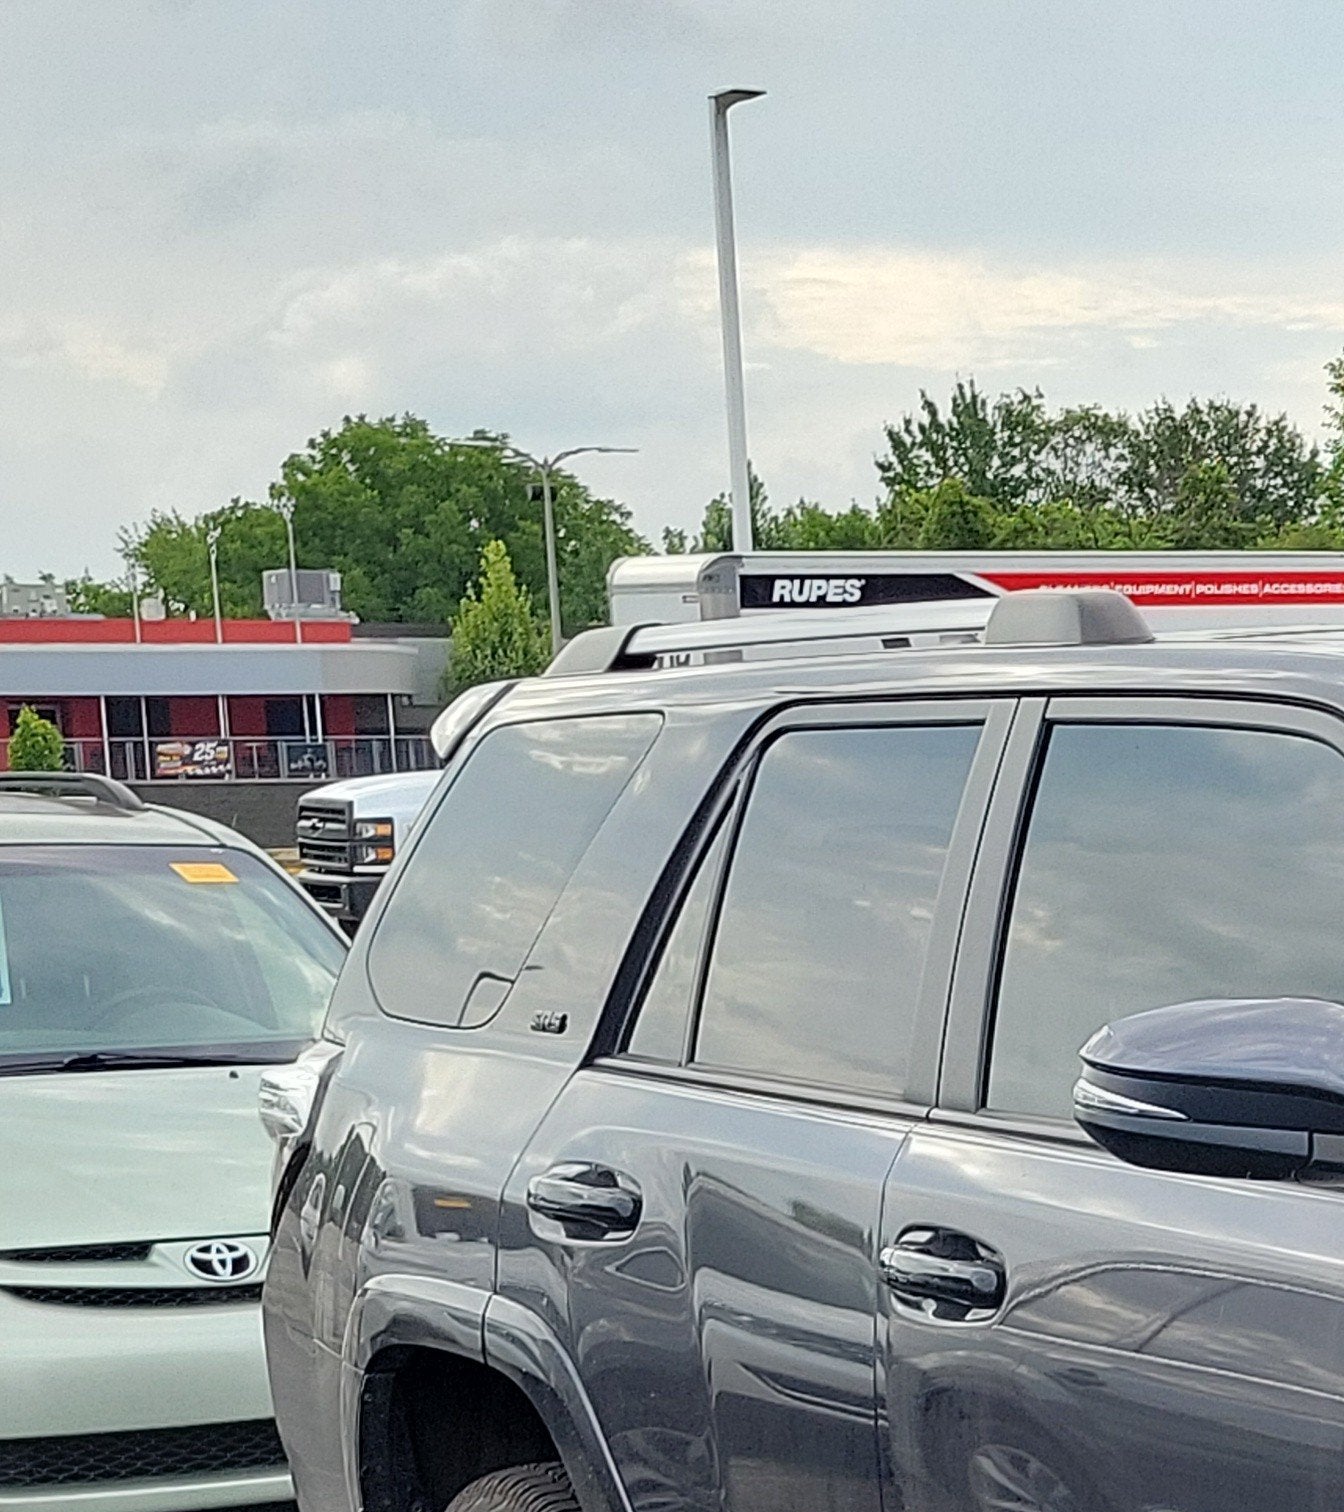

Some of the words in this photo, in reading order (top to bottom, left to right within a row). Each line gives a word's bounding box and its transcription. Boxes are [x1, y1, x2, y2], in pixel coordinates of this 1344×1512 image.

[772, 579, 862, 603] RUPES
[1115, 583, 1191, 595] EQUIPMENT
[1196, 583, 1258, 595] POLISHES
[193, 741, 218, 761] 25
